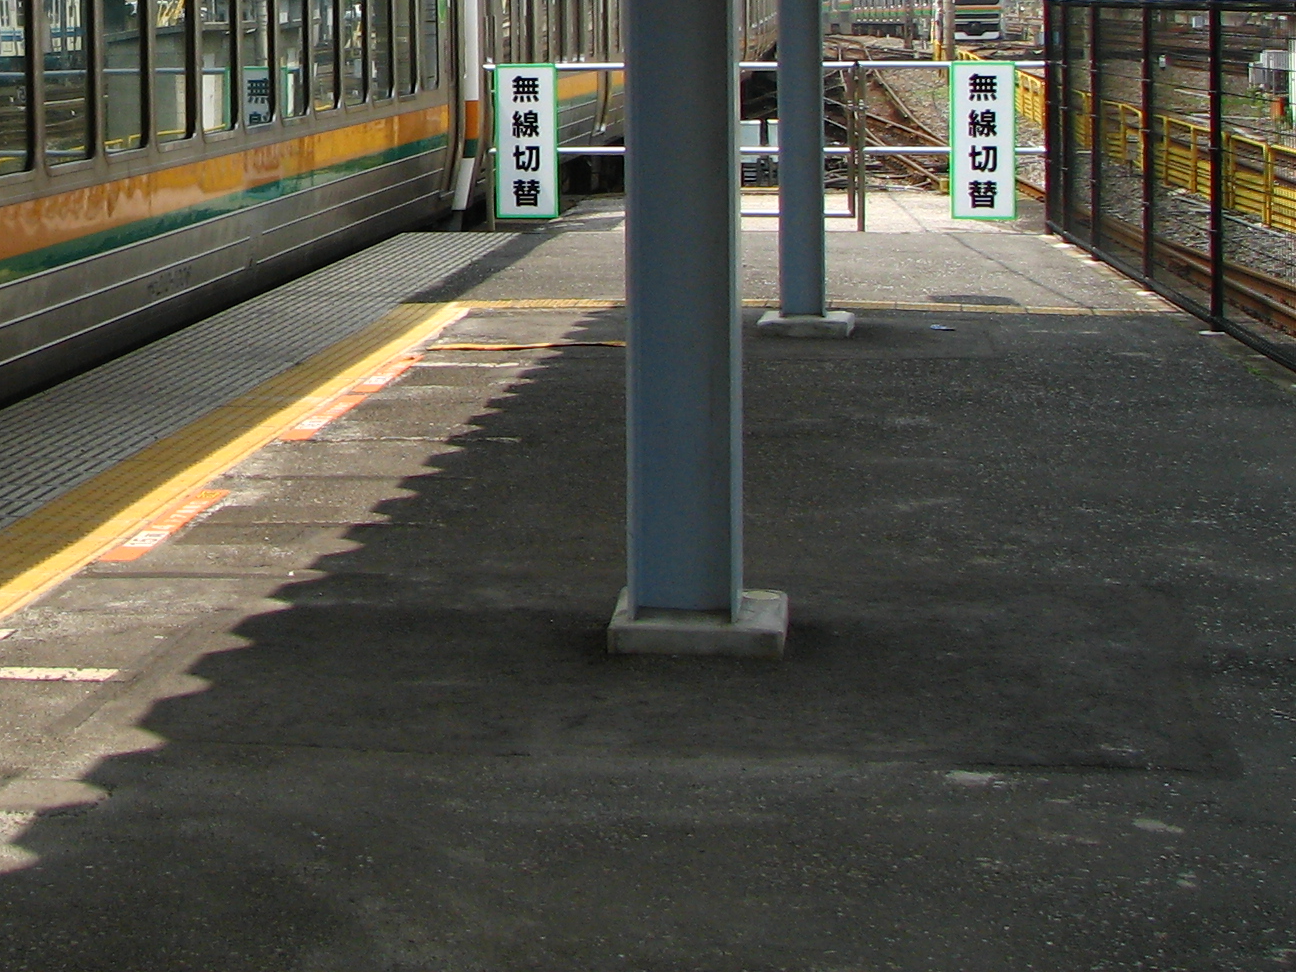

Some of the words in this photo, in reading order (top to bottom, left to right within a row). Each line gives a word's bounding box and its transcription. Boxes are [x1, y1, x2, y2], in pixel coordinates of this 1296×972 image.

[512, 75, 540, 207] 無線切替
[968, 73, 998, 209] 無線切替
